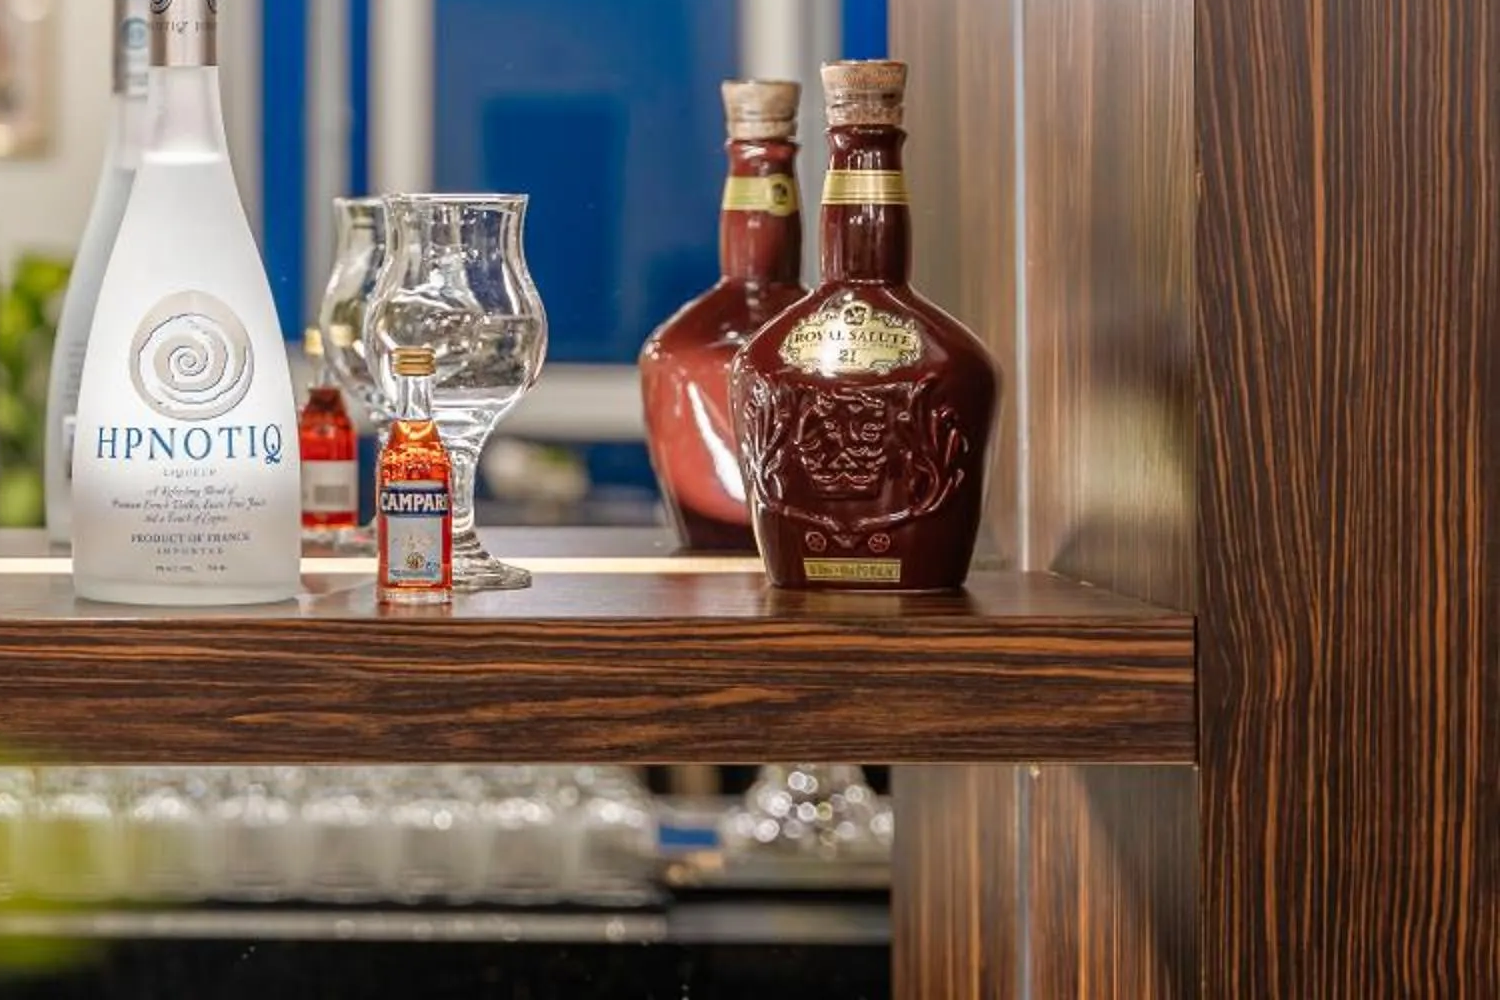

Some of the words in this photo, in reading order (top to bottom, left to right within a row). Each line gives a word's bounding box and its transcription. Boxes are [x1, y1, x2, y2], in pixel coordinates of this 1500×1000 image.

[850, 331, 912, 346] SALUTE
[97, 423, 282, 464] HPNOTIQ
[131, 533, 184, 543] PRODUCT
[188, 533, 202, 542] OF
[206, 532, 250, 542] FRANCE
